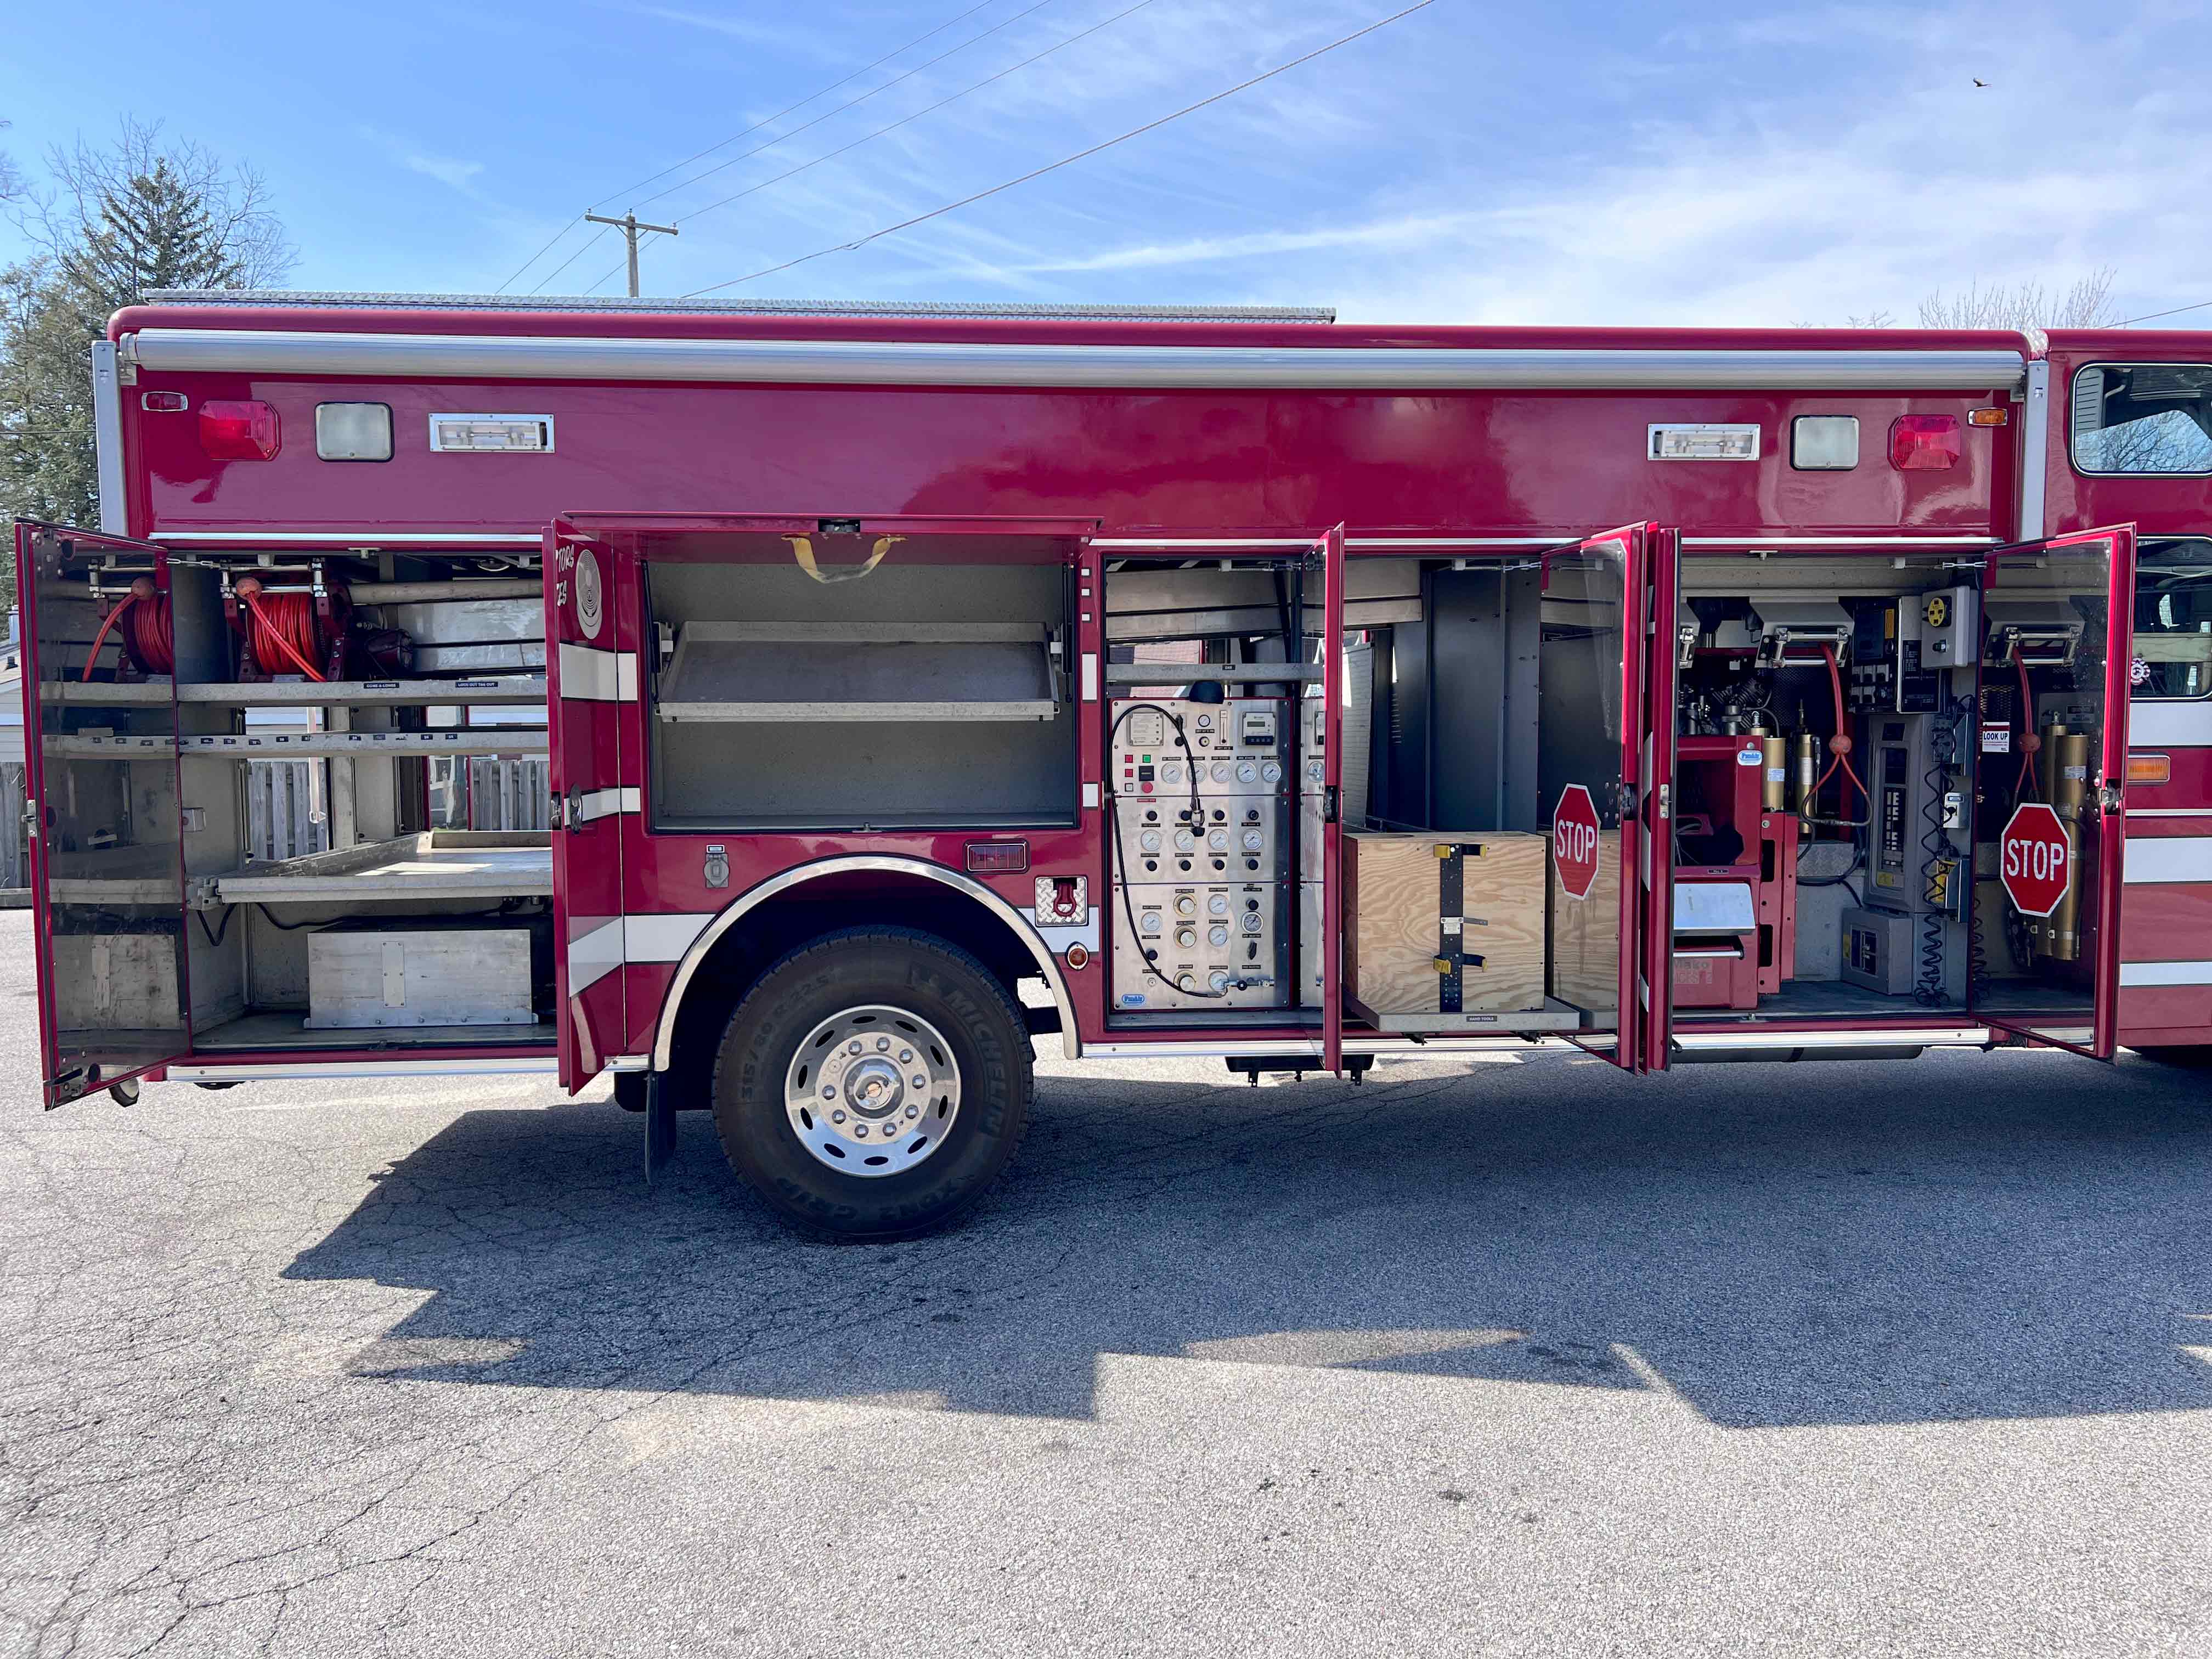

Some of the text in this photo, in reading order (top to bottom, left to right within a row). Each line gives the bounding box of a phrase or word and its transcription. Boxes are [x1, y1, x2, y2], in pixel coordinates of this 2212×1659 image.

[556, 544, 574, 573] TORS
[1556, 819, 1595, 864] STOP
[2006, 838, 2064, 881] STOP
[944, 989, 1006, 1137] MICHELIN
